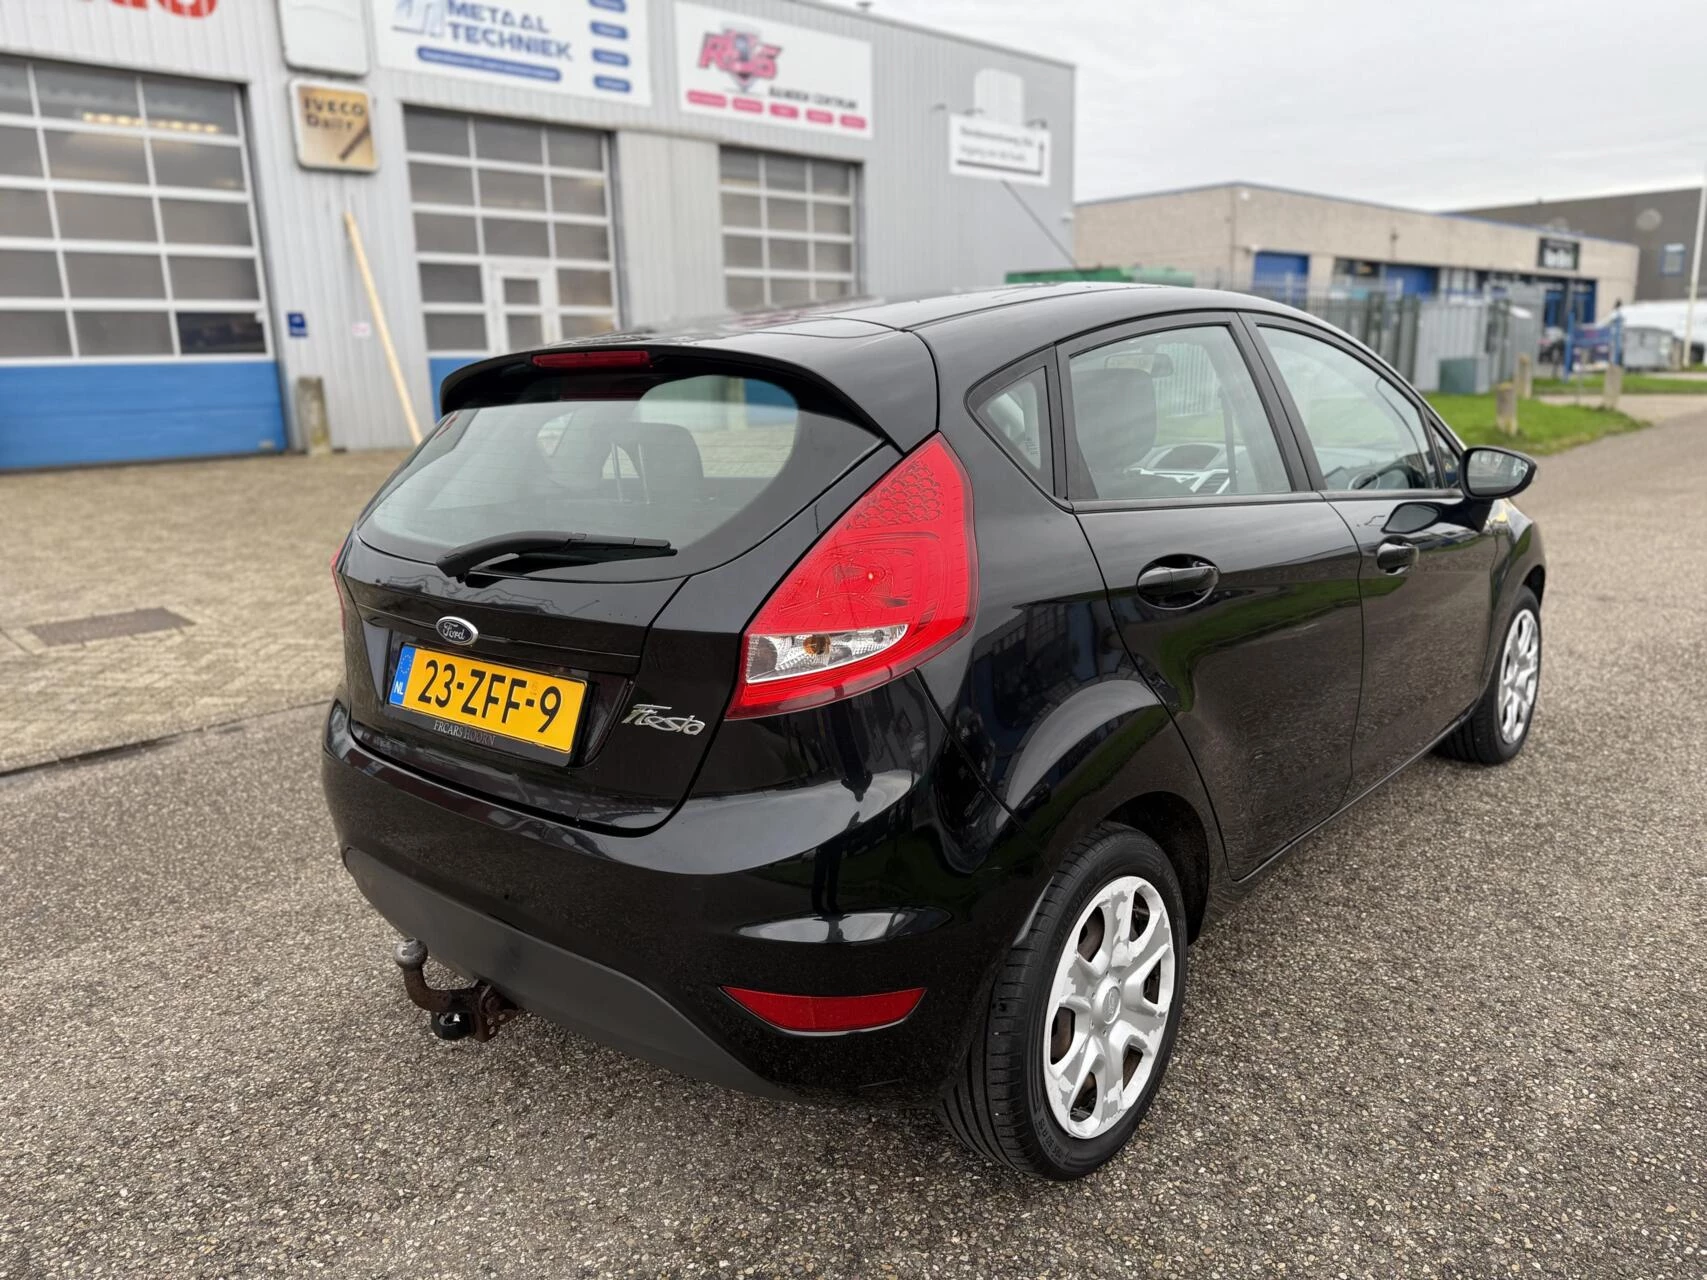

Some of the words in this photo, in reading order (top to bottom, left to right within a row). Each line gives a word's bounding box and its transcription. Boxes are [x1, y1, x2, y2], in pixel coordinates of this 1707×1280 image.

[447, 0, 549, 34] METAAL
[448, 21, 573, 62] TECHNIEK
[303, 96, 366, 117] IVECO
[442, 621, 465, 640] Ford
[393, 681, 404, 695] NL
[417, 659, 562, 733] 23-ZFF-9
[433, 720, 463, 738] FRCARS
[463, 727, 496, 745] HOORN
[621, 704, 705, 735] Fiesta
